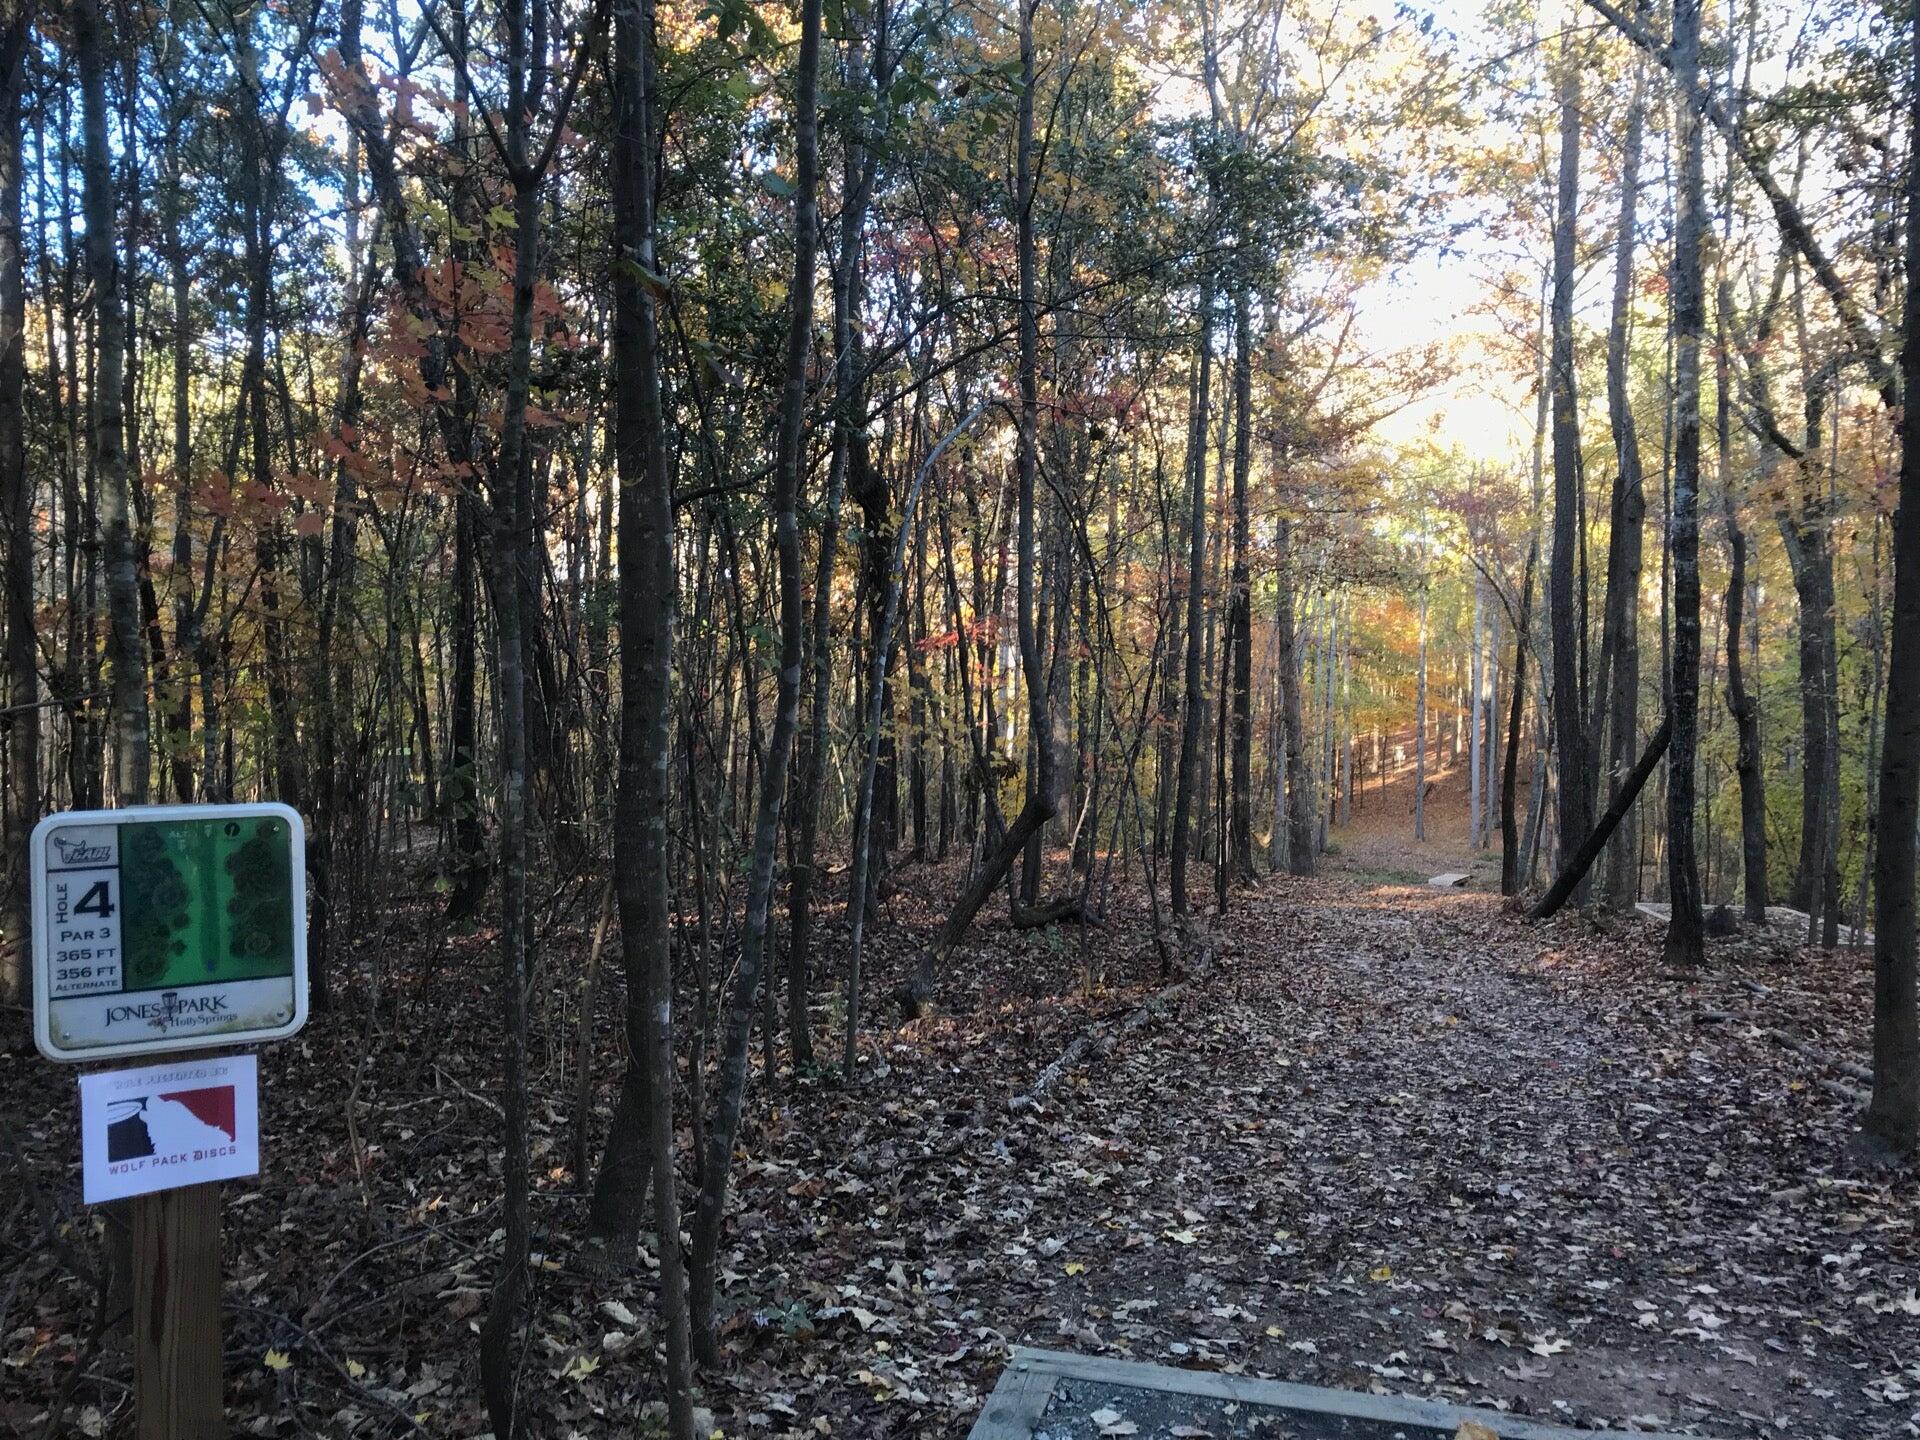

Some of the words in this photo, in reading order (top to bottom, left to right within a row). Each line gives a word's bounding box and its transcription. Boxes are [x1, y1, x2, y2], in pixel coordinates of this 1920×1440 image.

[55, 883, 68, 924] HOLE
[73, 881, 115, 919] 4
[60, 930, 95, 943] PAR
[99, 927, 111, 939] 3
[56, 949, 92, 963] 365
[96, 948, 117, 959] FT
[56, 967, 92, 981] 356
[96, 966, 117, 976] FT
[55, 979, 119, 992] ALTERNATE
[105, 1003, 161, 1027] JONES
[178, 994, 229, 1015] PARK
[108, 1159, 146, 1176] WOLF
[151, 1152, 188, 1168] PACK
[193, 1145, 237, 1163] DISCS
